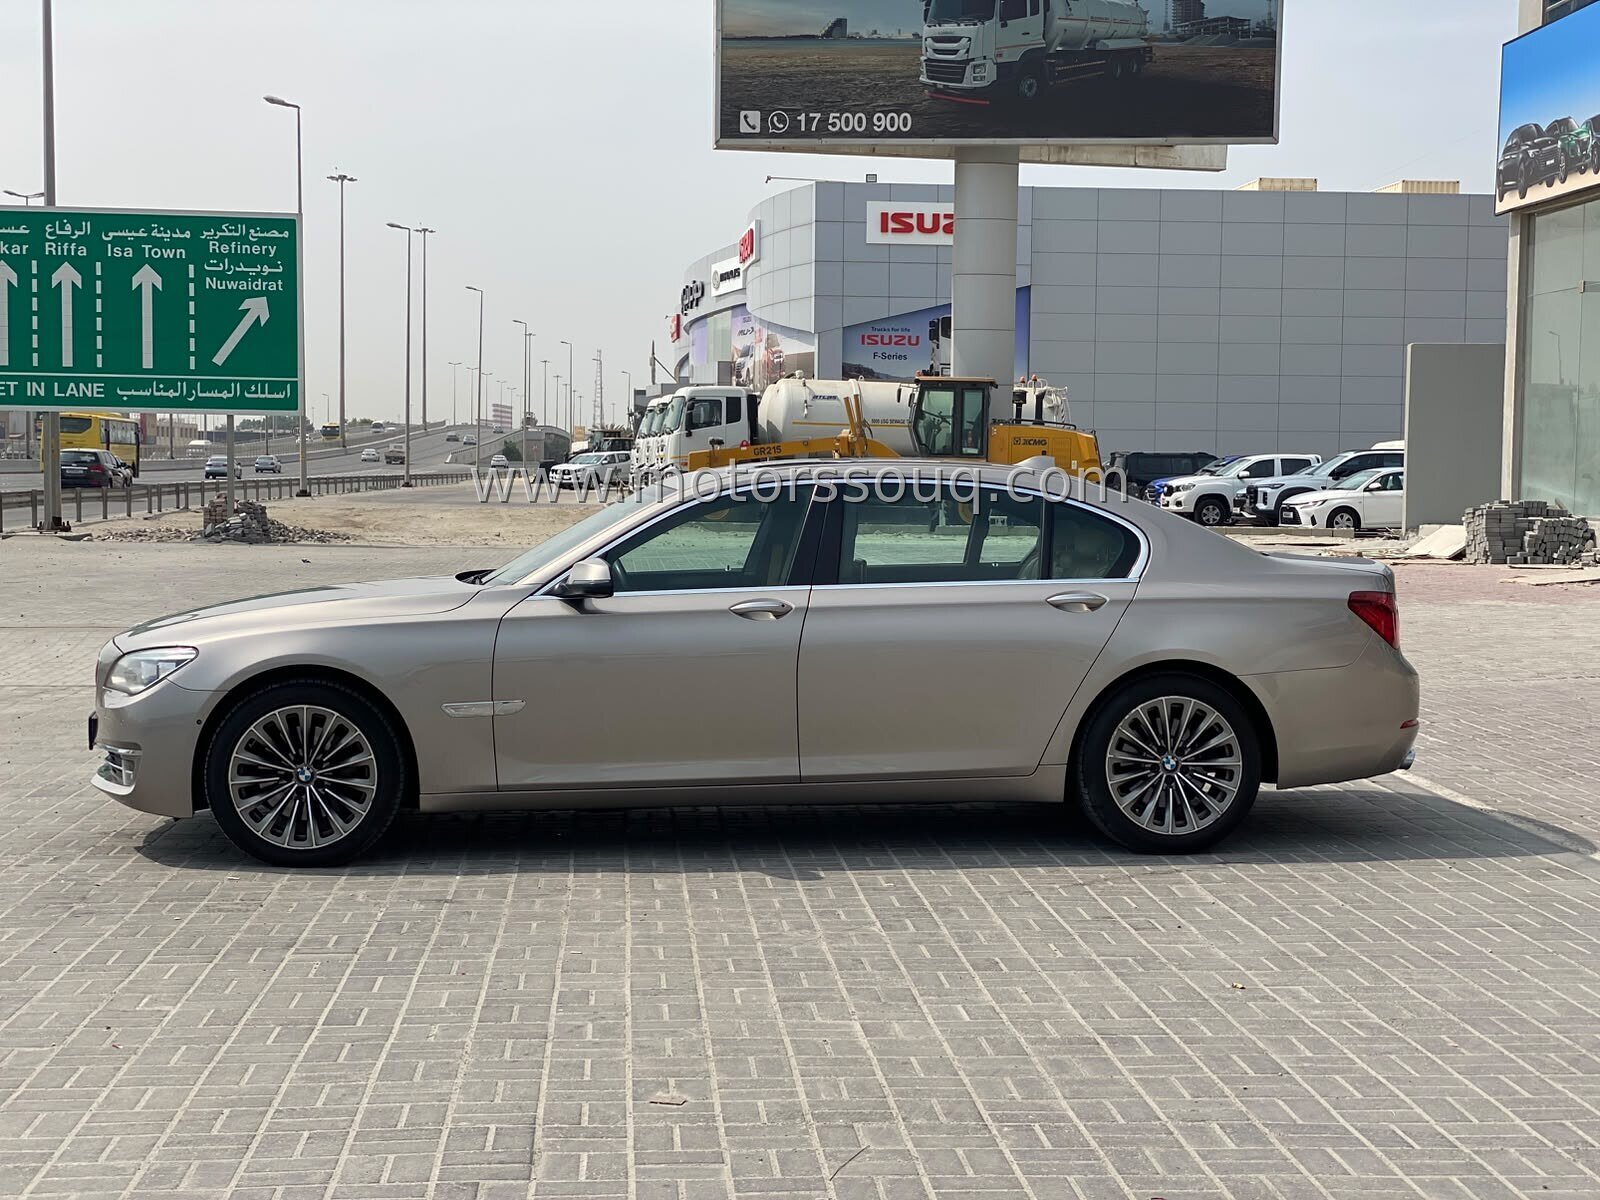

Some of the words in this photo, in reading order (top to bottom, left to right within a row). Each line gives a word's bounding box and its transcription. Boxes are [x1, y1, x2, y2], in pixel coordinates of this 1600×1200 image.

[797, 113, 821, 131] 17
[827, 113, 867, 132] 500
[873, 113, 912, 132] 900
[45, 219, 91, 240] الرفاع
[102, 228, 148, 241] عيسى
[151, 223, 191, 242] مدينة
[200, 223, 246, 239] التكرير
[249, 227, 289, 241] مصنع
[45, 242, 87, 256] Riffa
[107, 244, 133, 257] Isa
[141, 245, 186, 259] Town
[209, 241, 277, 257] Refinery
[204, 258, 283, 275] نويدرات
[206, 277, 284, 291] Nuwaidrat
[861, 334, 921, 346] ISUZU
[873, 352, 908, 361] F-Series
[27, 381, 45, 397] IN
[54, 382, 105, 398] LANE
[116, 380, 187, 401] المناسب
[187, 381, 240, 401] المسار
[244, 383, 291, 399] اسلك
[1022, 438, 1048, 446] XCMG
[753, 445, 782, 456] GR215
